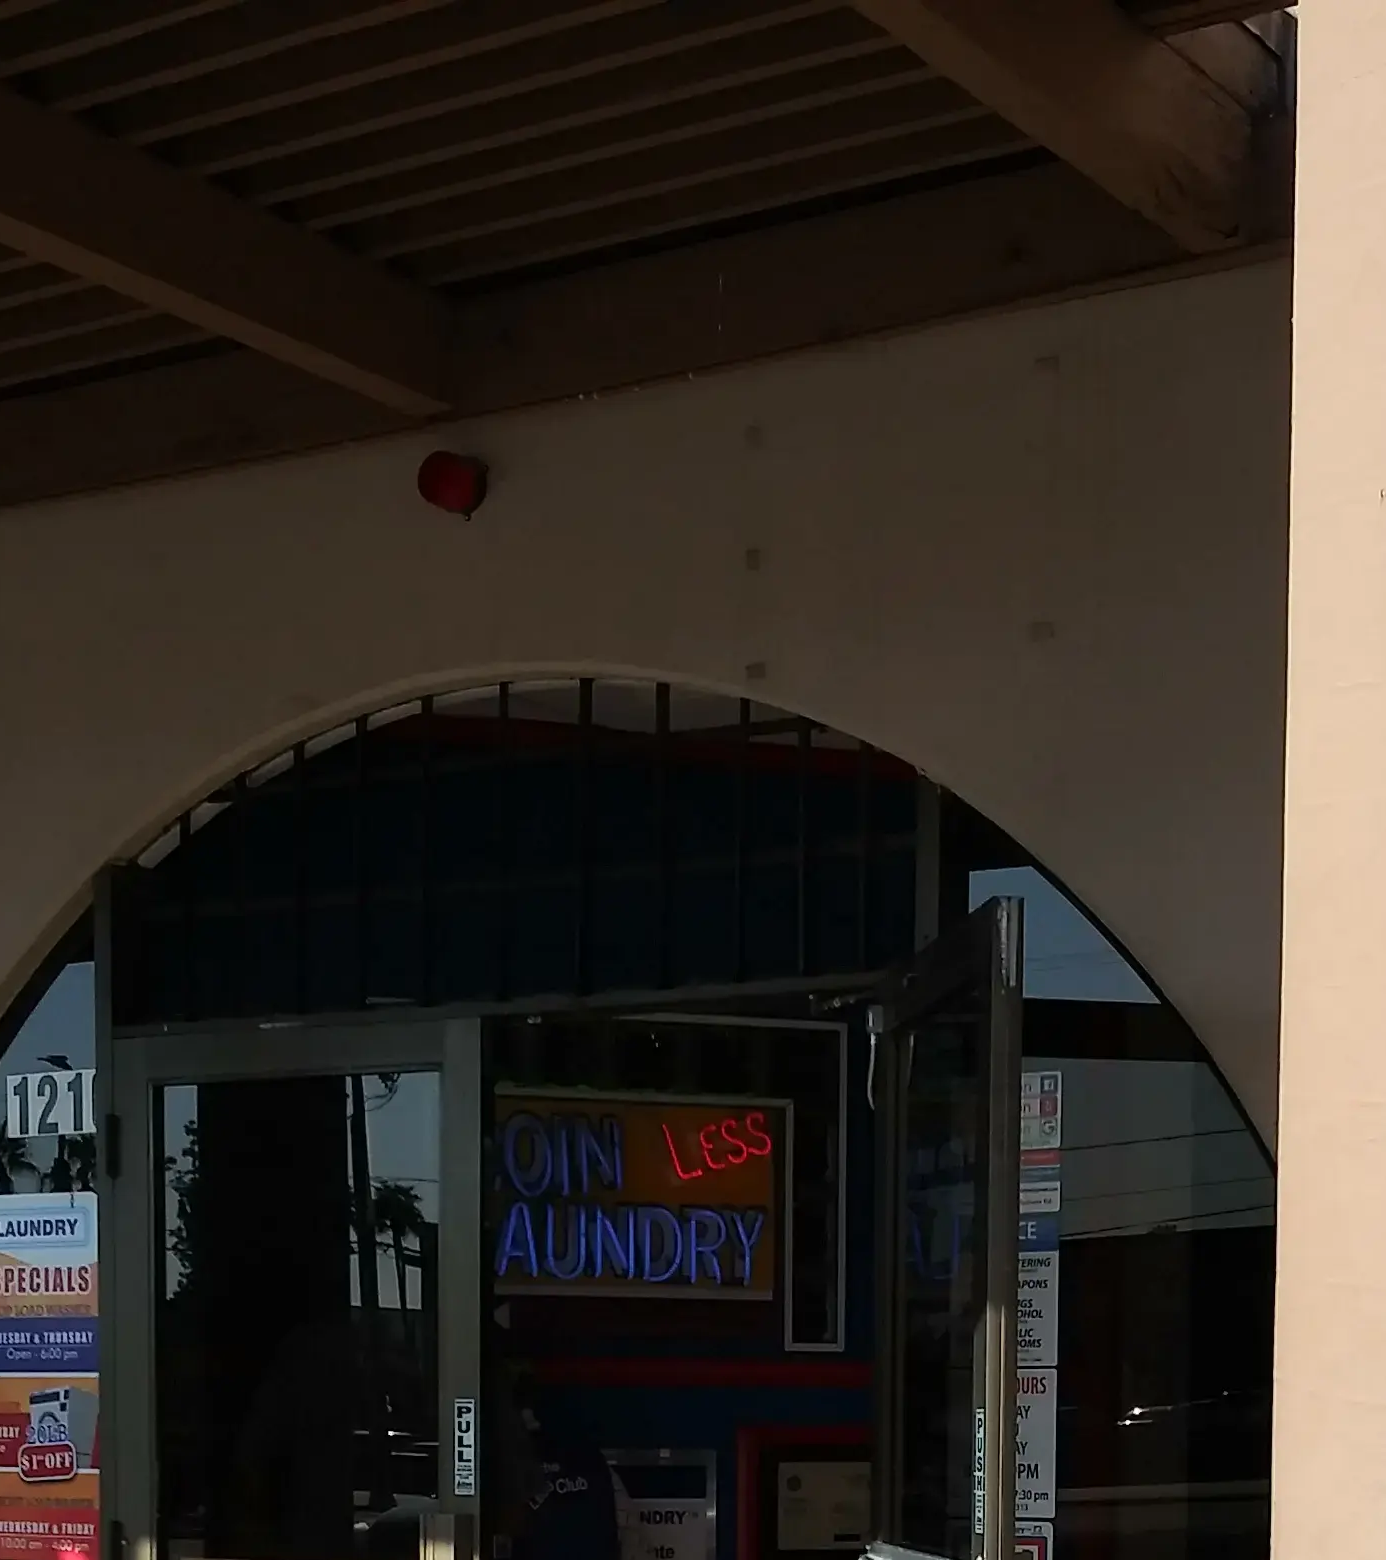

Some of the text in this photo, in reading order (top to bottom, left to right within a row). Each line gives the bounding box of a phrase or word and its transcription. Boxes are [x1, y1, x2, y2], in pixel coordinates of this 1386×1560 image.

[505, 1111, 771, 1198] OIN LESS
[496, 1202, 764, 1287] AUNDRY
[43, 1331, 93, 1344] THURSDAY
[7, 1348, 32, 1361] Open
[456, 1406, 472, 1463] PULL
[45, 1451, 74, 1469] OFF
[556, 1476, 589, 1494] Club
[1034, 1492, 1049, 1503] pm
[61, 1523, 95, 1535] FRIDAY
